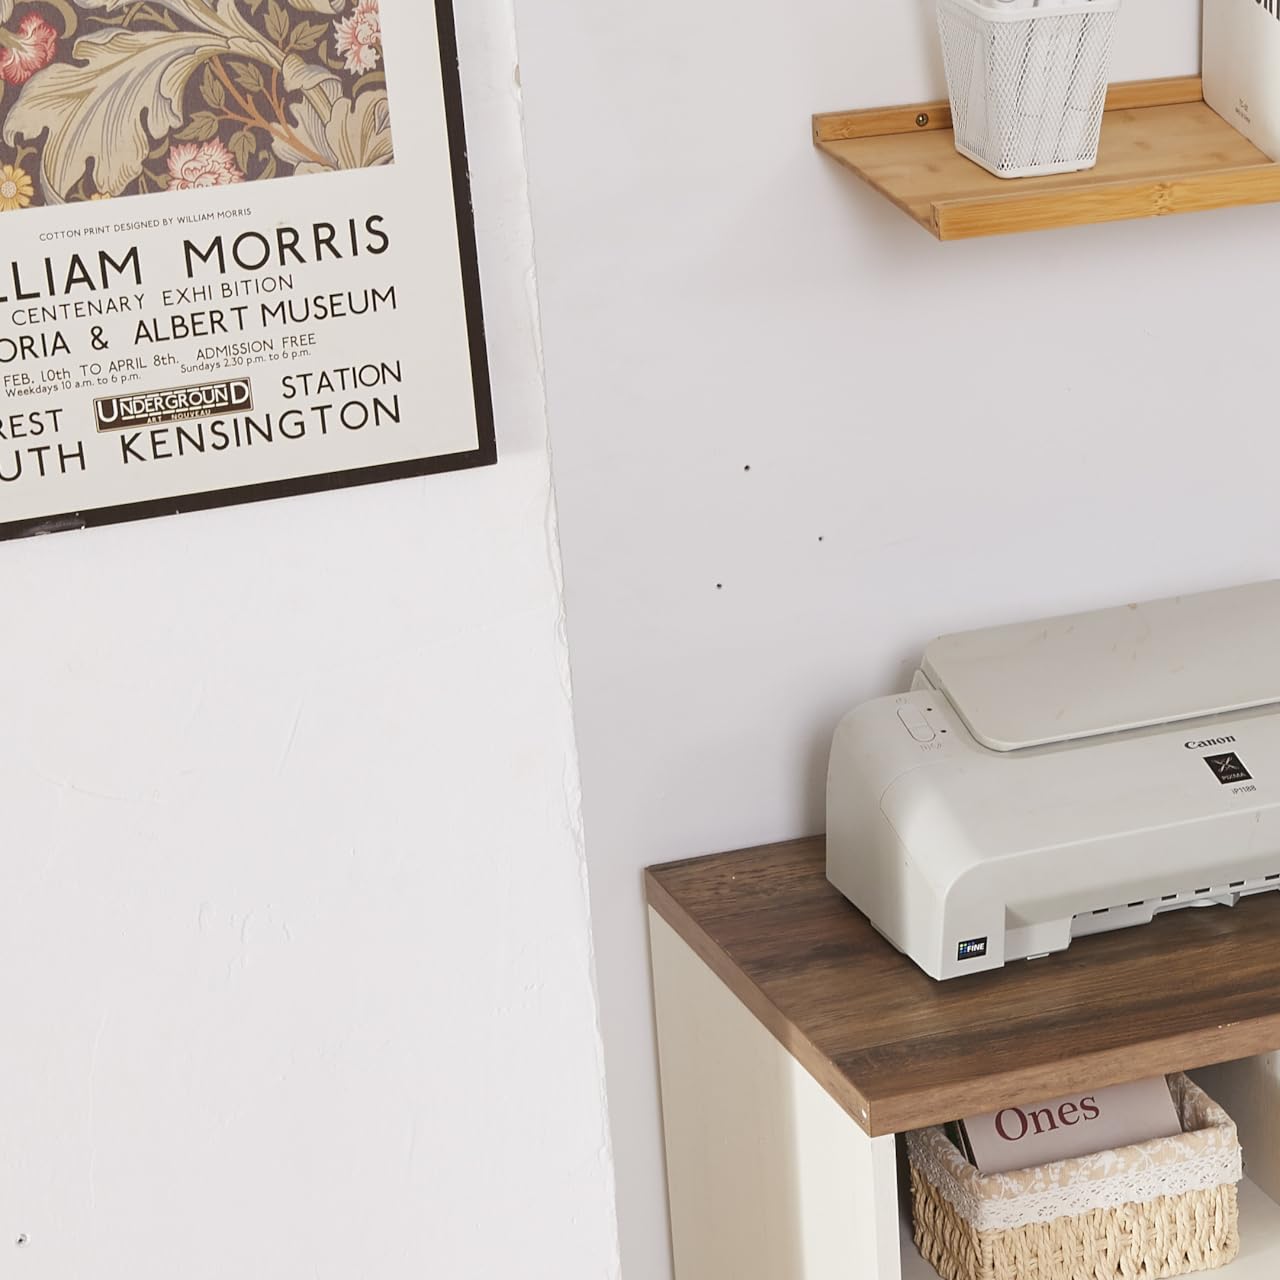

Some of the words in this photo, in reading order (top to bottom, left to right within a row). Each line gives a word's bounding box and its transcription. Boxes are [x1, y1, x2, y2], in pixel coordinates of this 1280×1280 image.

[39, 228, 82, 242] COTTON
[84, 224, 111, 235] PRINT
[114, 219, 160, 233] DESIGNED
[163, 217, 174, 226] BY
[176, 212, 215, 224] WILLIAM
[217, 207, 253, 220] MORRIS
[183, 214, 390, 279] MORRIS
[11, 293, 146, 327] CENTENARY
[91, 326, 109, 351] &
[134, 305, 249, 345] ALBERT
[260, 285, 398, 328] MUSEUM
[3, 373, 35, 388] FEB.
[80, 363, 101, 376] TO
[108, 357, 147, 374] APRIL
[153, 353, 180, 367] 8th.
[196, 339, 274, 361] ADMISSION
[282, 333, 317, 351] FREE
[5, 383, 59, 398] Weekdays
[61, 381, 72, 390] 10
[97, 376, 109, 385] to
[111, 374, 118, 383] 6
[180, 359, 221, 374] Sundays
[223, 356, 244, 367] 2.30
[269, 352, 280, 361] to
[282, 350, 289, 359] 6
[97, 381, 249, 423] UNDERGROUND
[281, 360, 403, 400] STATION
[119, 394, 401, 465] KENSINGTON
[147, 415, 163, 425] ART
[171, 408, 212, 421] NOUVEAU
[1184, 734, 1236, 750] Canon
[966, 941, 985, 953] FINE
[994, 1094, 1101, 1142] Ones
